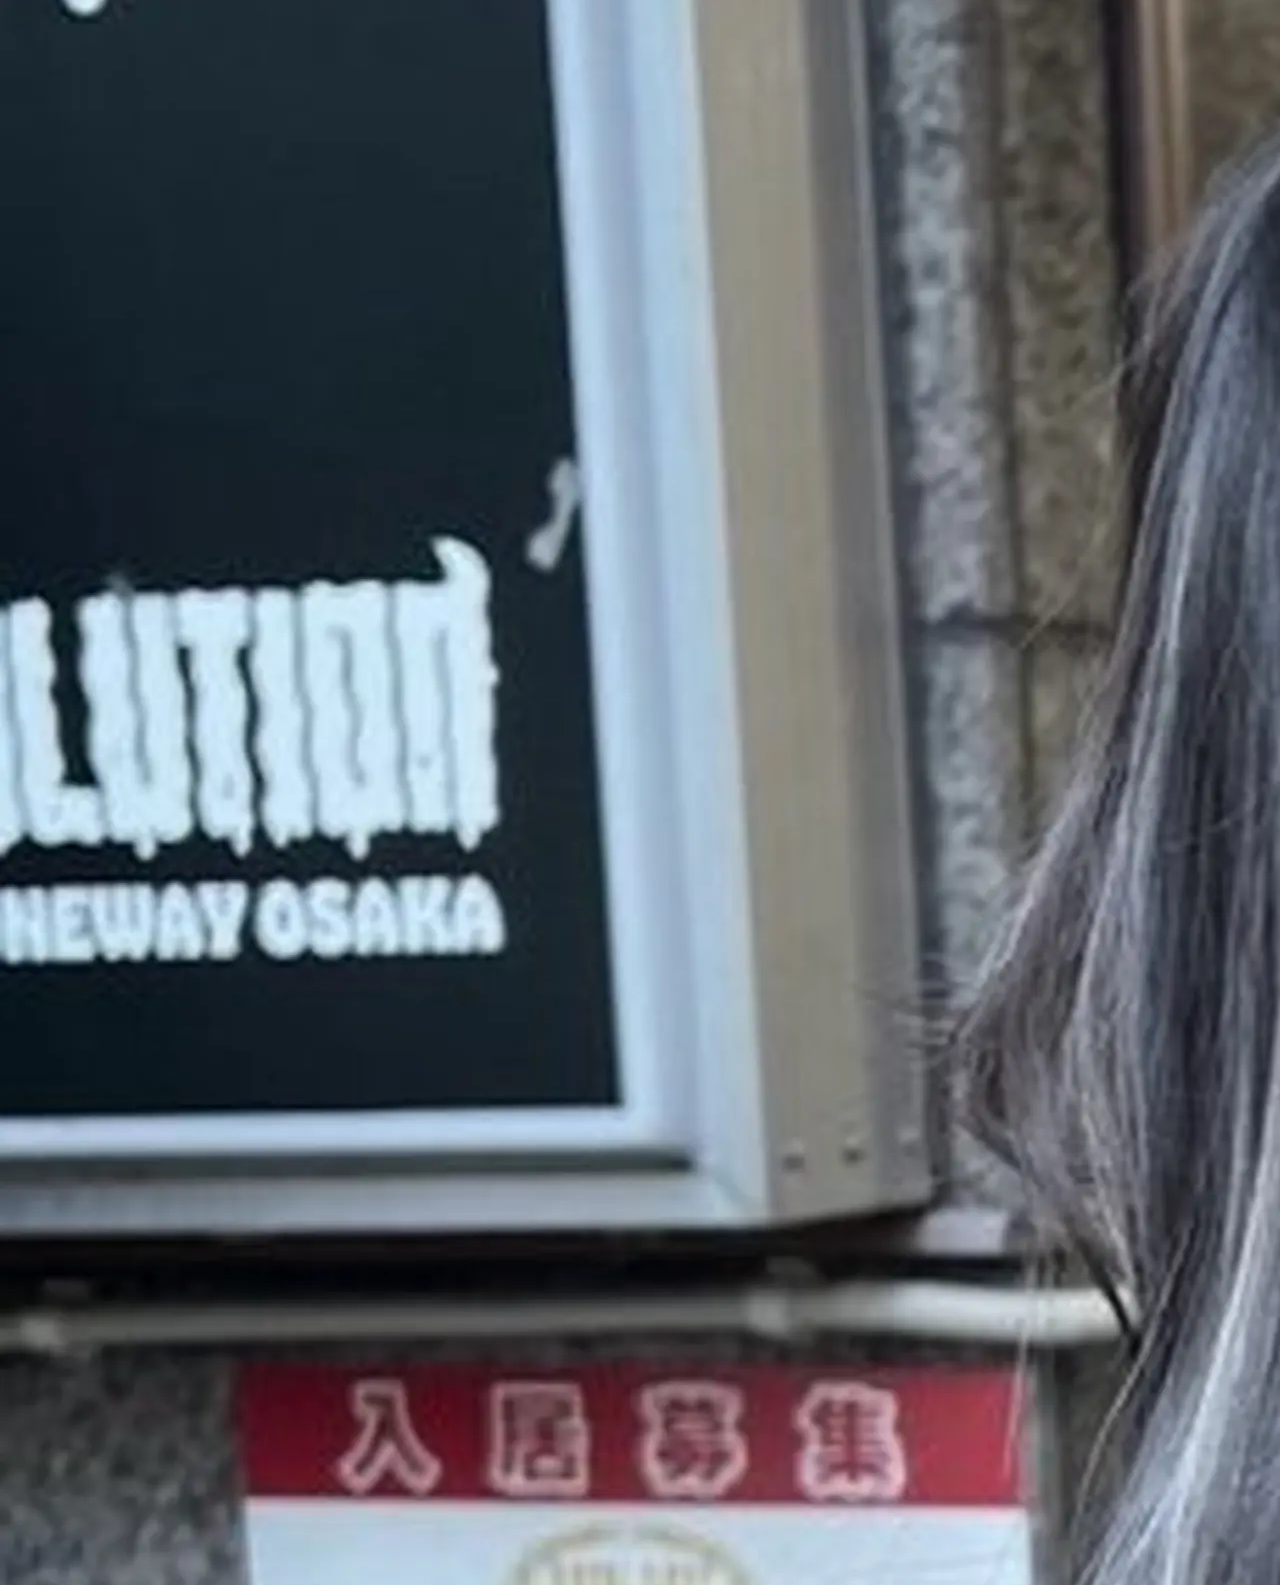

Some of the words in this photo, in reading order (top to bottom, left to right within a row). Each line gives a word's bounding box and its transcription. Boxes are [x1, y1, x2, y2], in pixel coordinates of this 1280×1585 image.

[0, 535, 499, 860] LUTION
[254, 874, 505, 959] OSAKA
[336, 1378, 907, 1500] 入居募集
